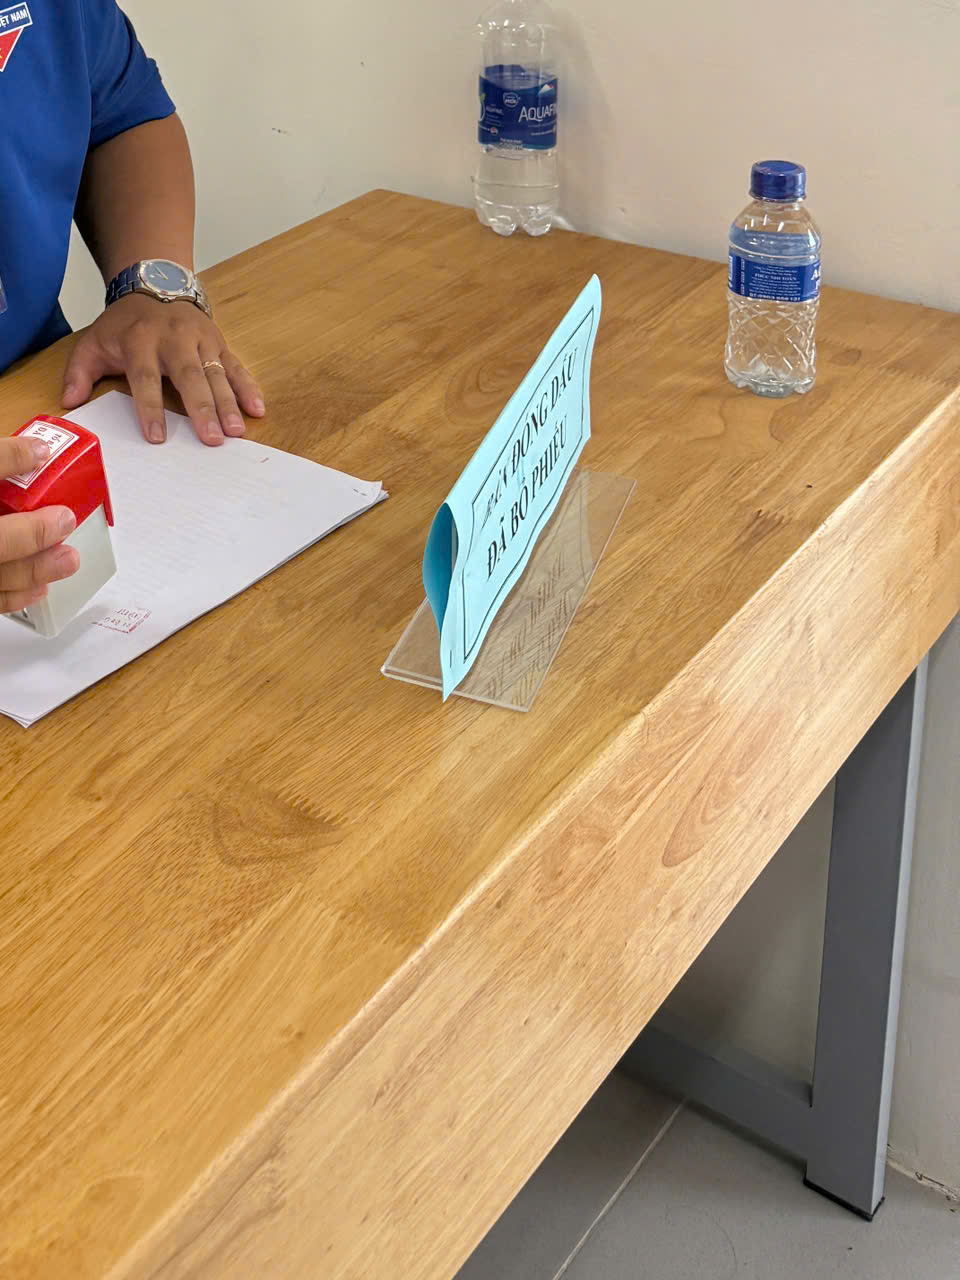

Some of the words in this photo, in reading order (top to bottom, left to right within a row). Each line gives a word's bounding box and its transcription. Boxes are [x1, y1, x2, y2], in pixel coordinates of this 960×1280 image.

[9, 8, 29, 23] NAM
[511, 392, 549, 478] ĐÓNG
[550, 348, 579, 412] DẤU
[486, 516, 507, 583] ĐÃ
[510, 477, 529, 542] BỎ
[530, 413, 568, 503] PHIẾU
